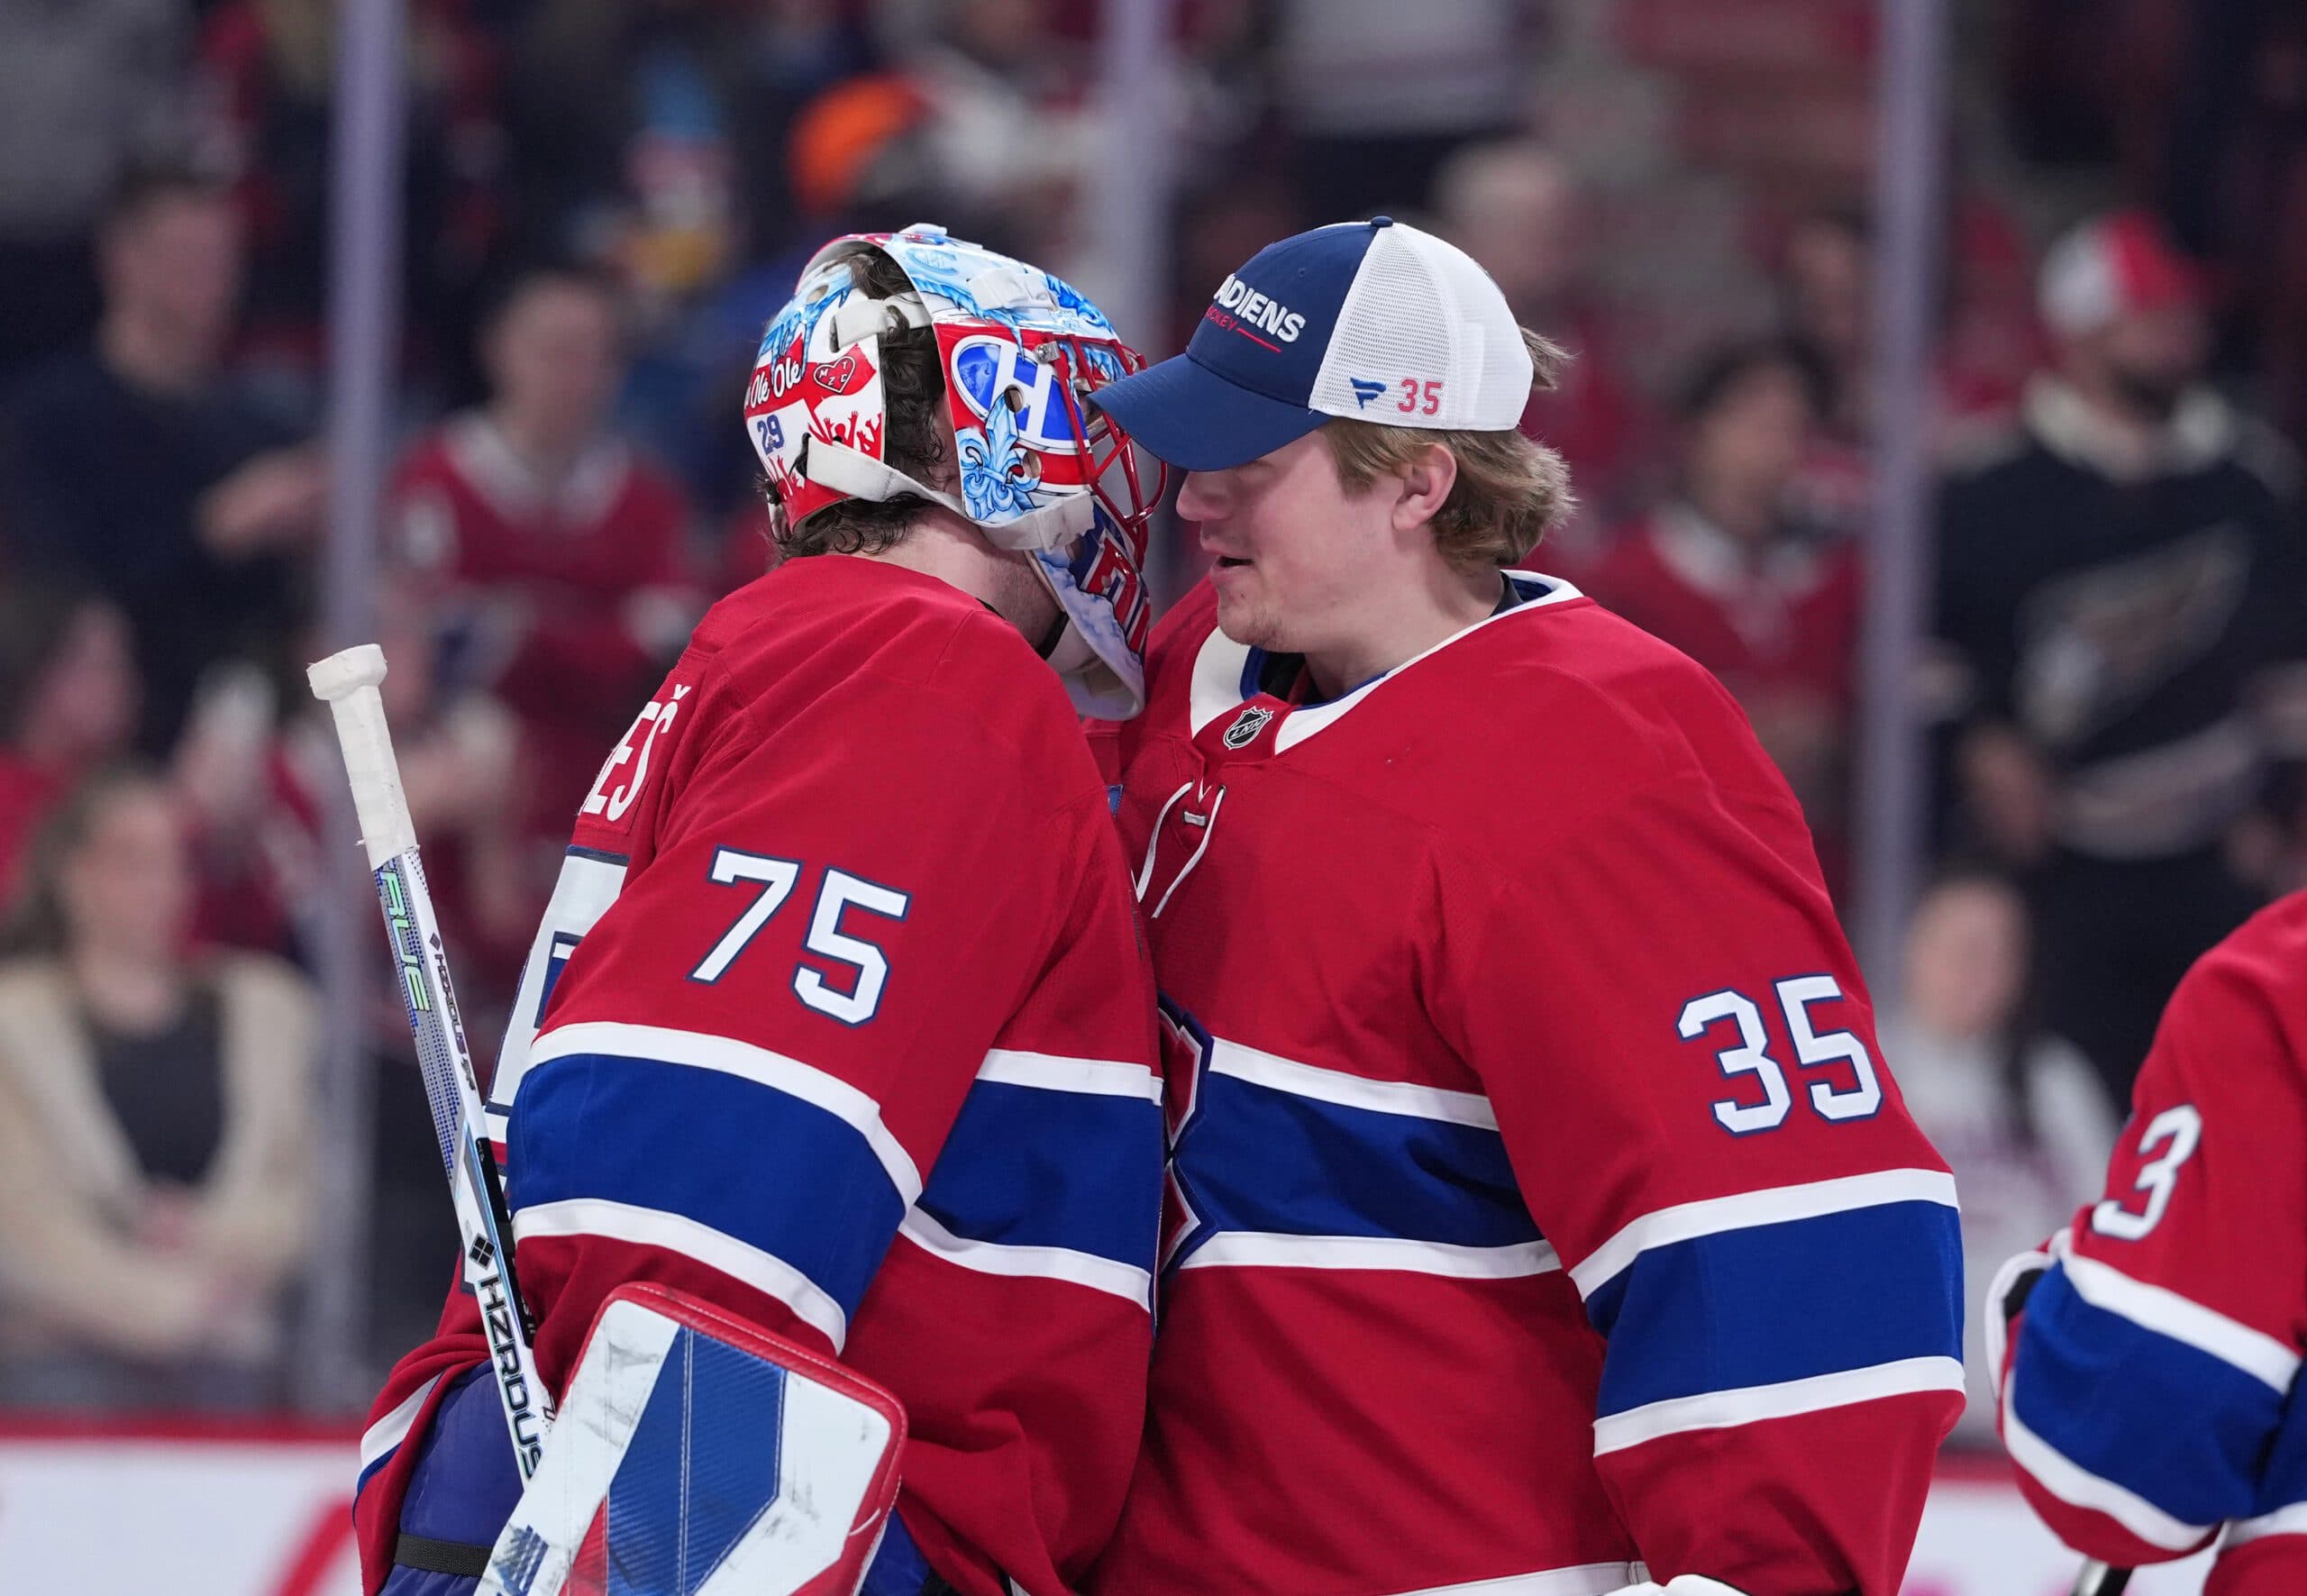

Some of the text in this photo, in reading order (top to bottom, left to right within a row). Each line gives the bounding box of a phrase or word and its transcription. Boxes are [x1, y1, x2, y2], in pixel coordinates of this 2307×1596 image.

[772, 357, 801, 397] Olé
[1213, 273, 1306, 342] ADIENS
[757, 414, 785, 455] 29
[1397, 377, 1444, 416] 35
[575, 684, 692, 822] EŠ
[379, 859, 431, 1012] RUE
[685, 844, 913, 1029] 75
[1675, 971, 1883, 1138] 35
[2090, 1100, 2203, 1243] 3
[479, 1274, 543, 1481] HZRDUS
